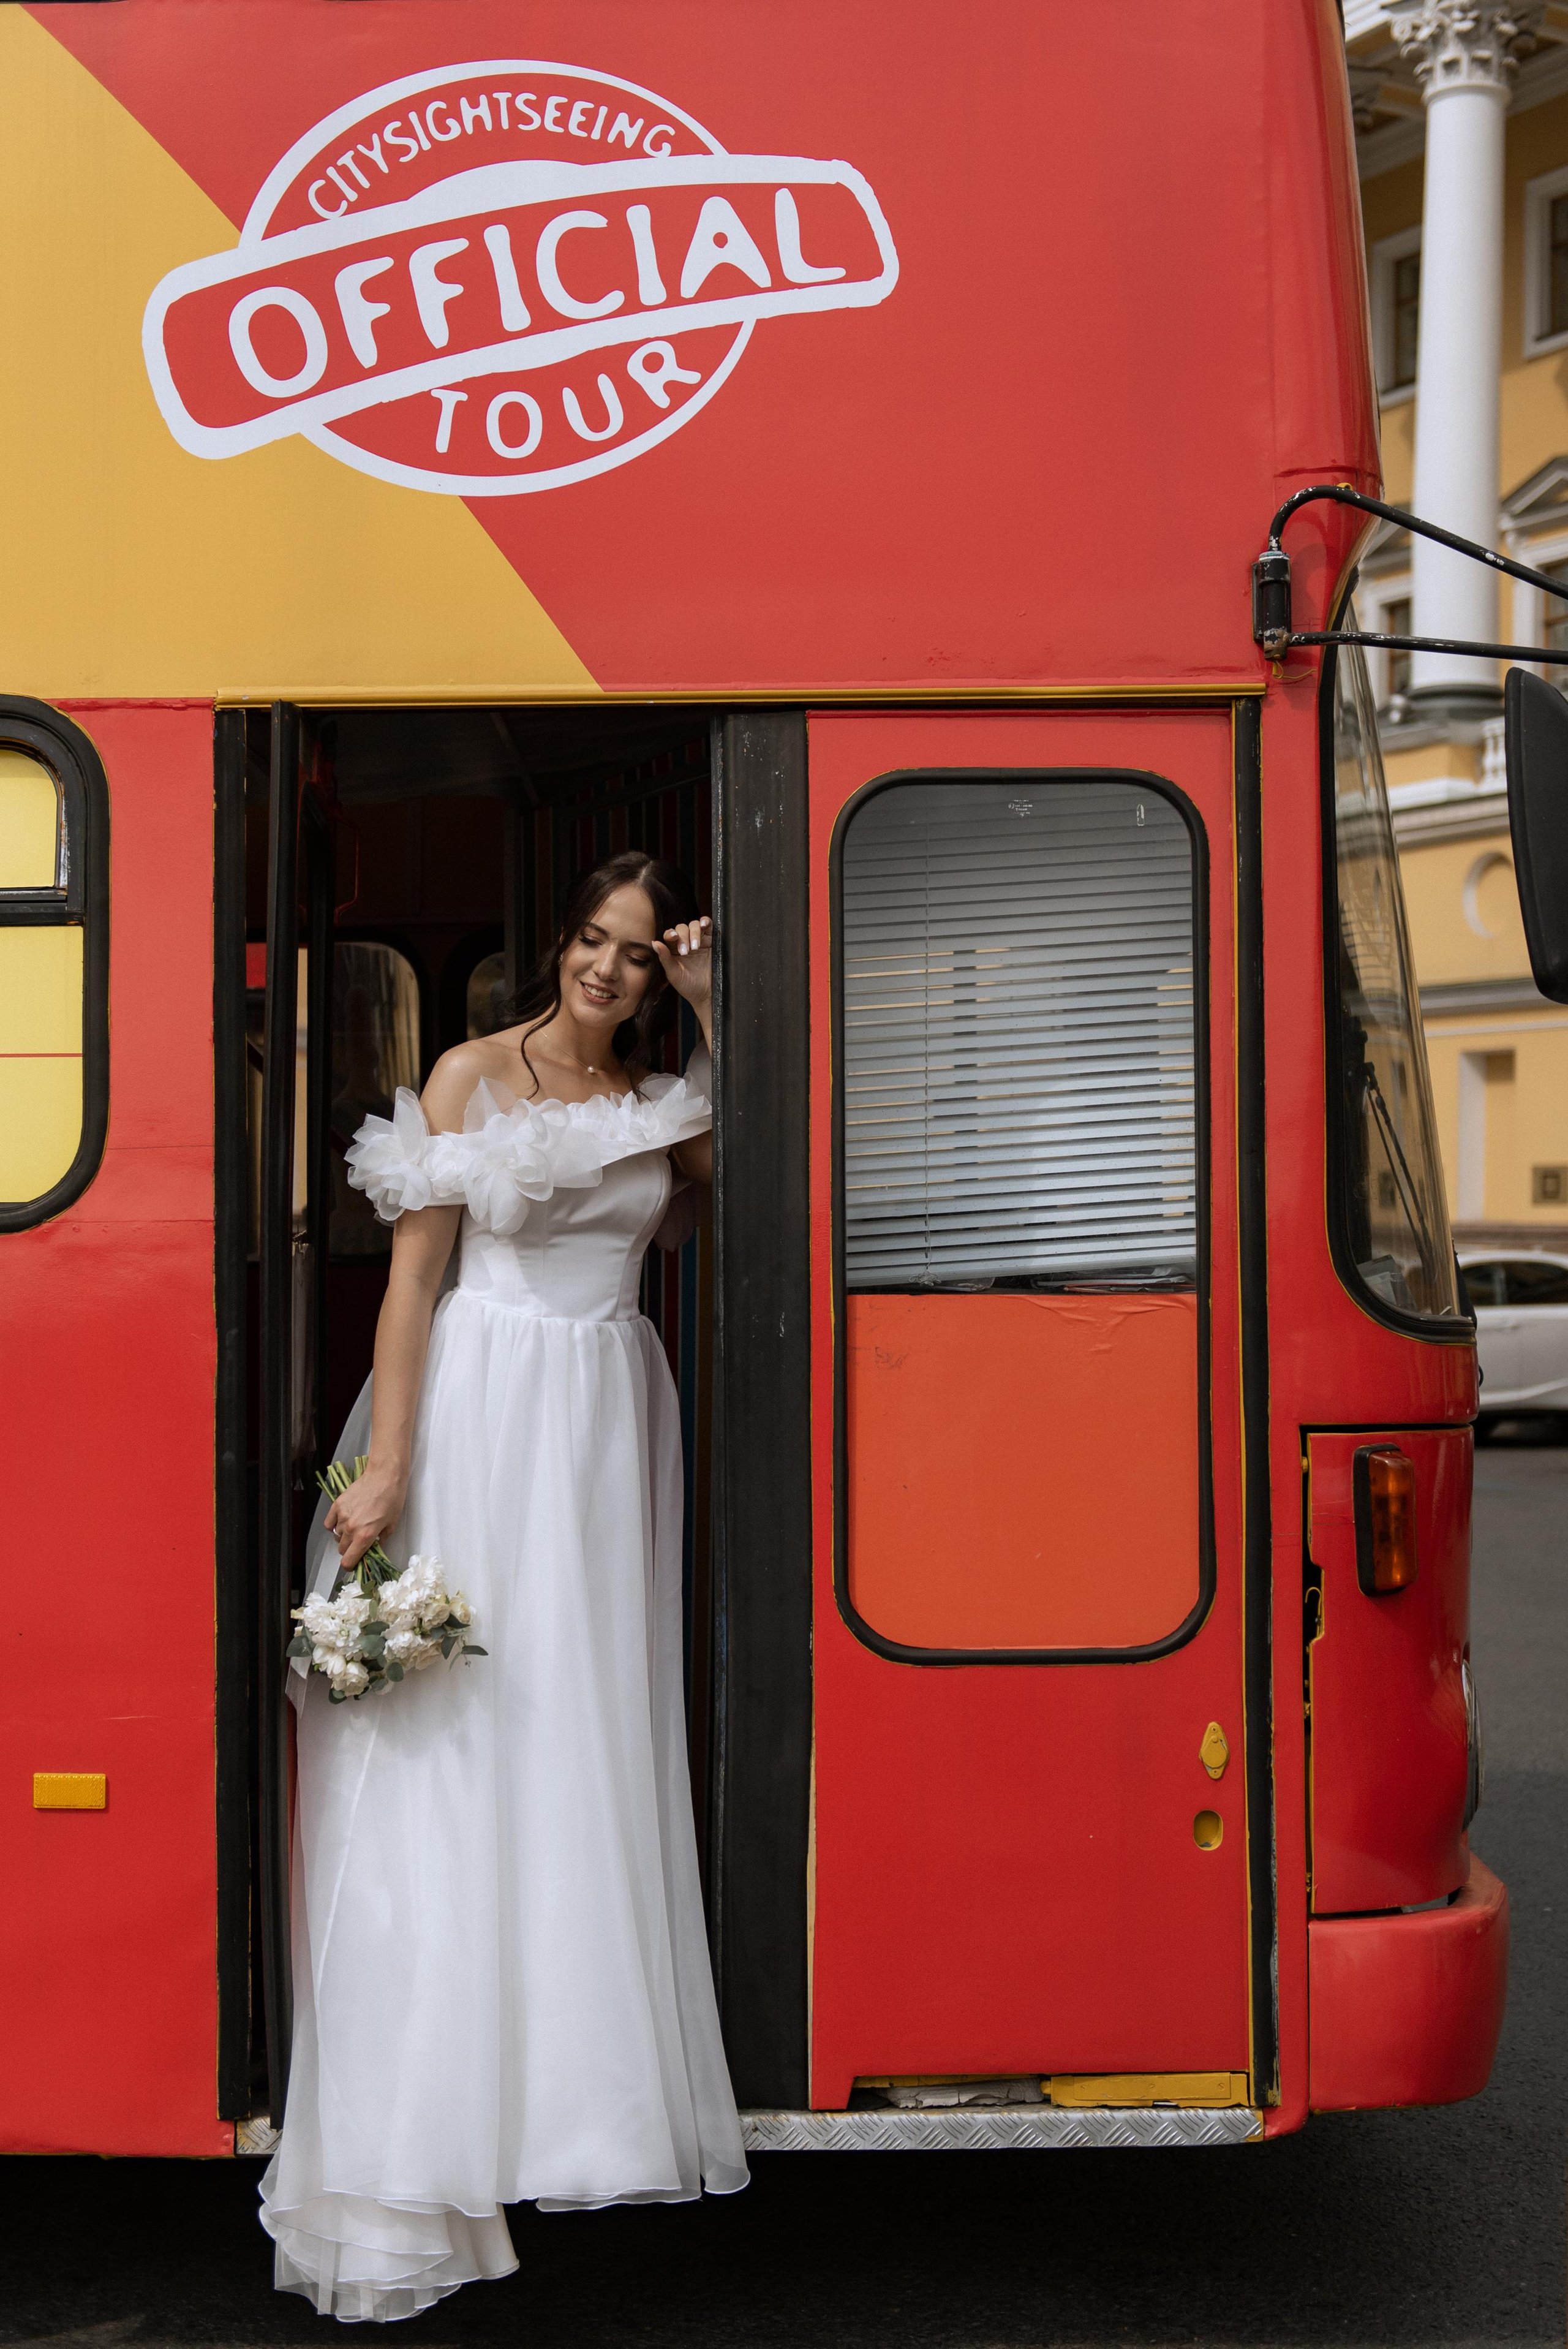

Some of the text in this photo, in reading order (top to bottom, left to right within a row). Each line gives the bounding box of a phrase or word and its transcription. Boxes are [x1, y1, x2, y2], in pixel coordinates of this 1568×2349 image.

[307, 91, 676, 220] CITYSIGHTSEEING
[228, 187, 846, 398] OFFICIAL
[431, 340, 701, 459] TOUR
